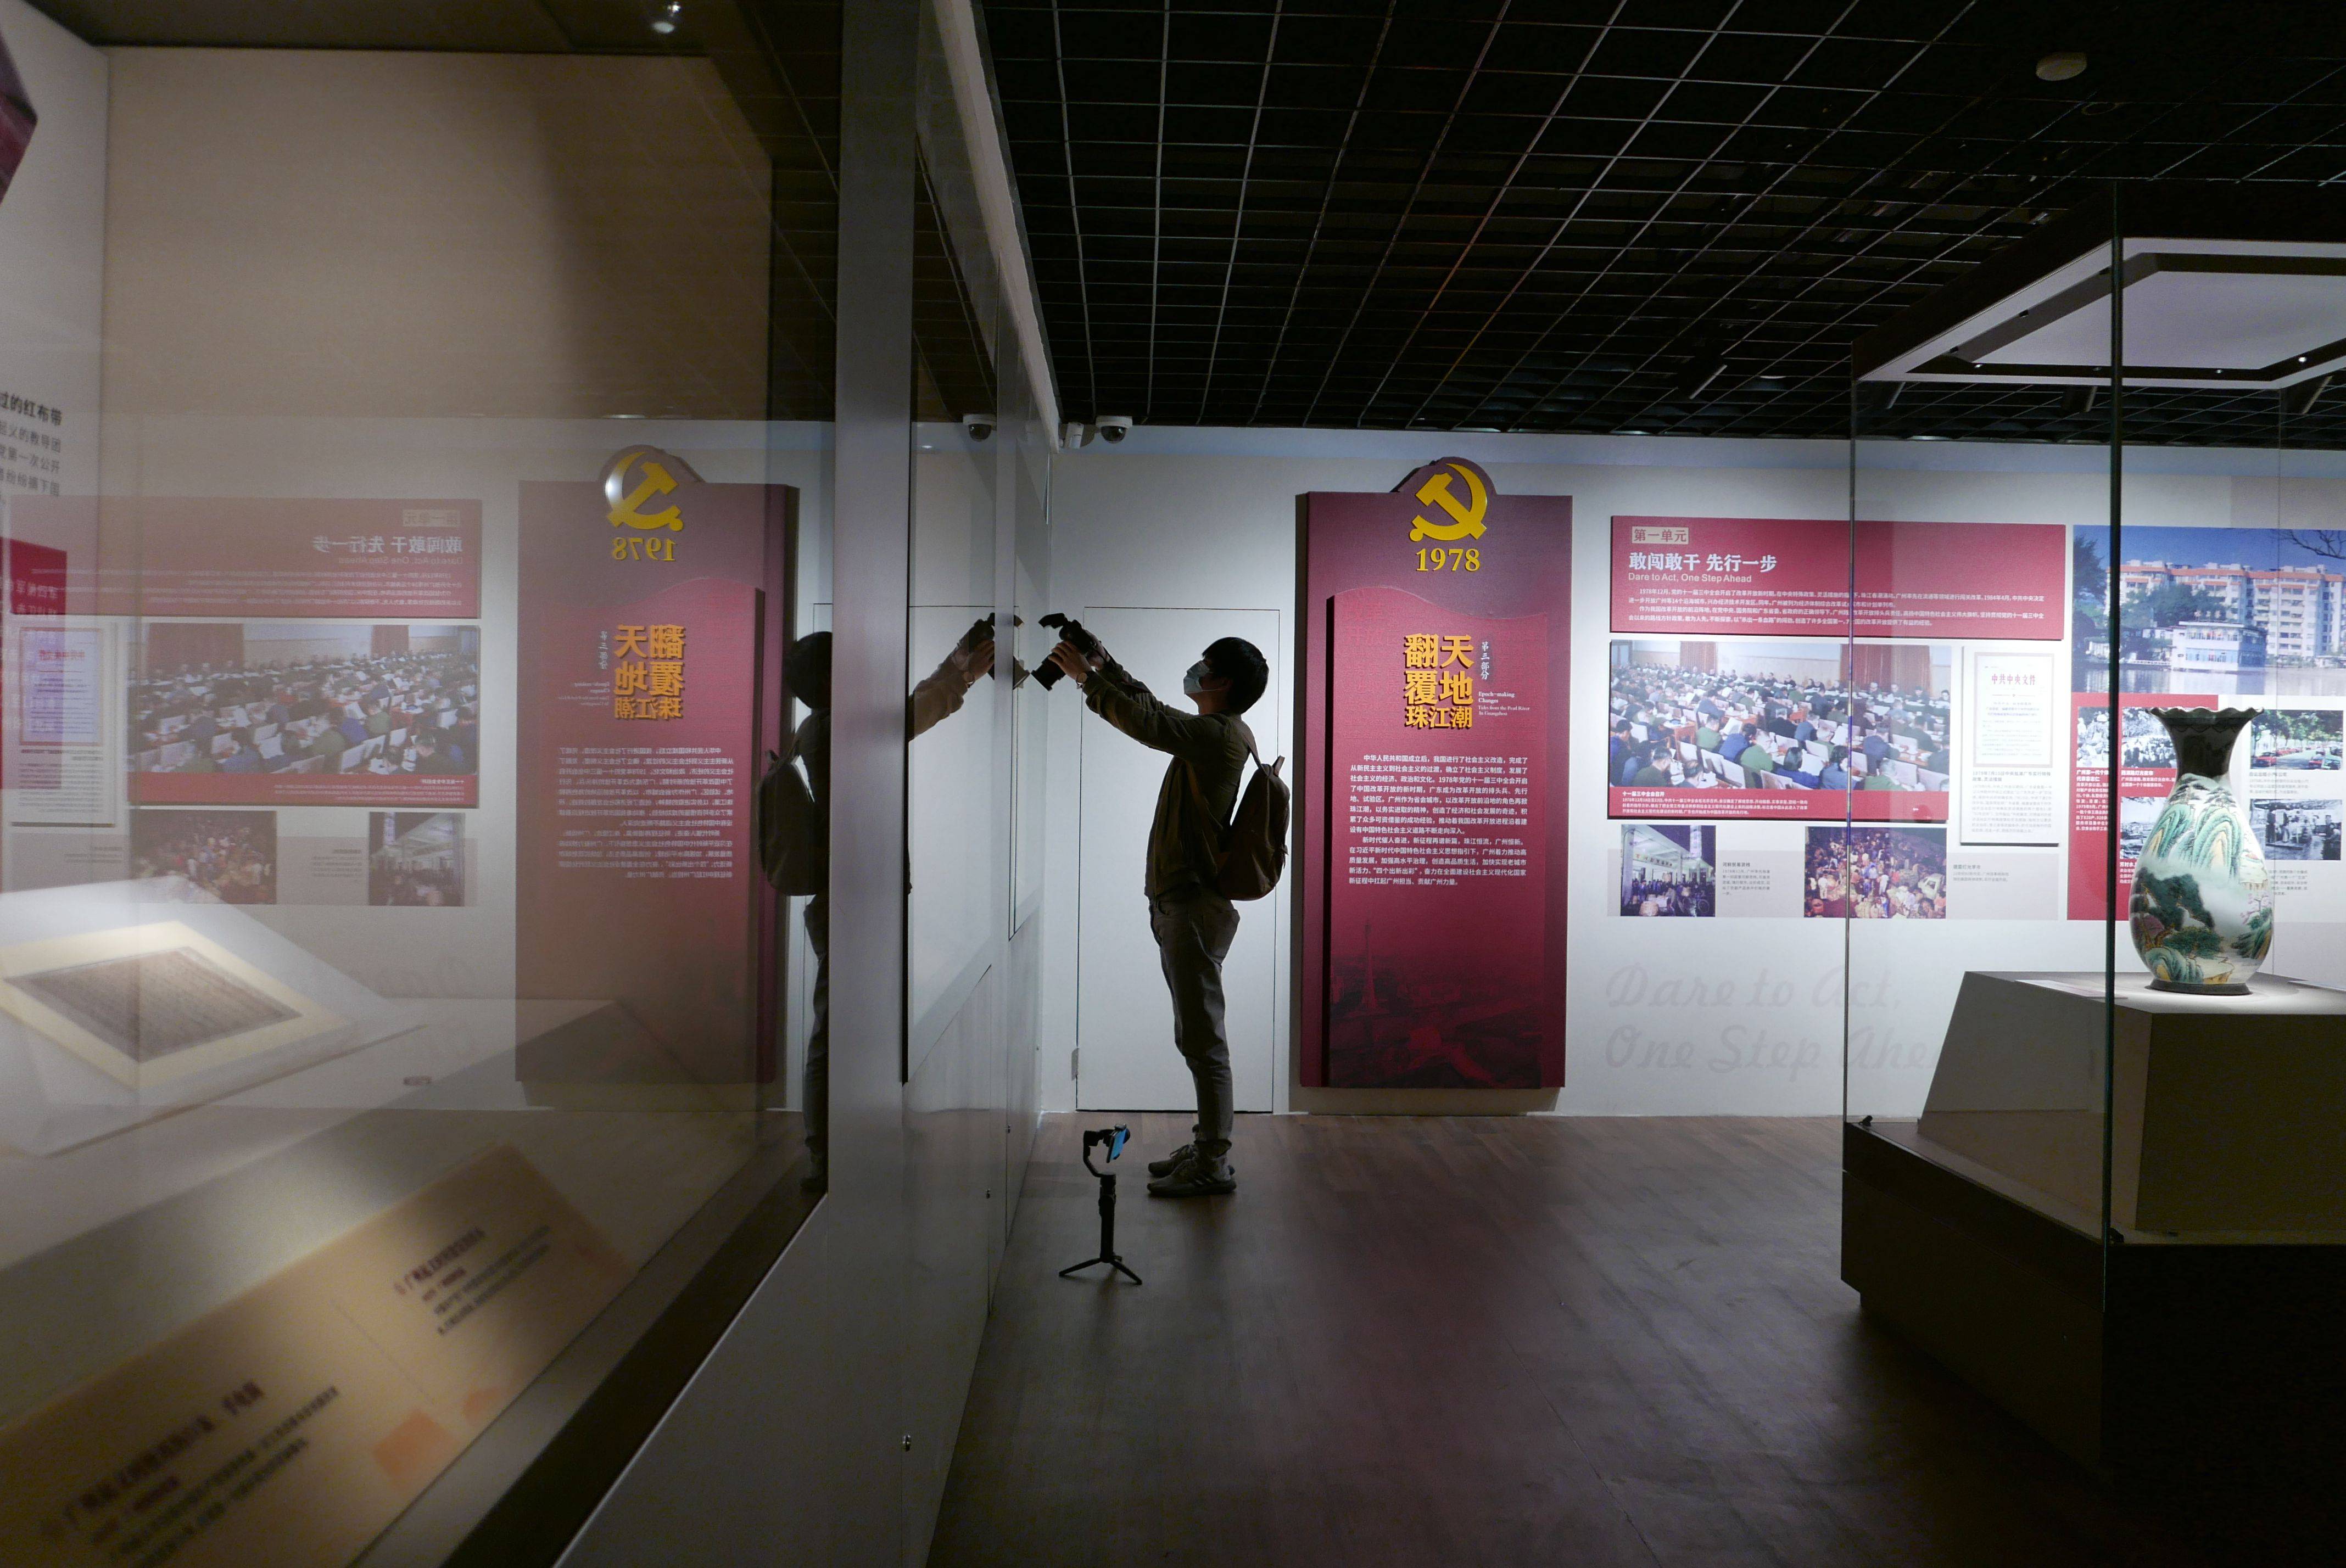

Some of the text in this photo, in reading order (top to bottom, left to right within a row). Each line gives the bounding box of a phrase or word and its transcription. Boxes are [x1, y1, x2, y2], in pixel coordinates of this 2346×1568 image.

[1633, 528, 1688, 542] 第一单元
[1416, 548, 1481, 572] 1978
[1629, 552, 1777, 573] 敢闯敢干 先行一步
[1661, 573, 1679, 583] Act,
[1681, 573, 1700, 582] One
[1701, 574, 1722, 584] Step
[1723, 574, 1752, 583] Ahead
[1481, 641, 1490, 680] 第三部分
[1991, 673, 2036, 686] 中共中央文件
[1404, 705, 1473, 729] 珠江潮
[1606, 962, 1902, 1011] Dare to Act,
[1605, 1024, 1695, 1069] One
[1707, 1024, 1824, 1083] Step
